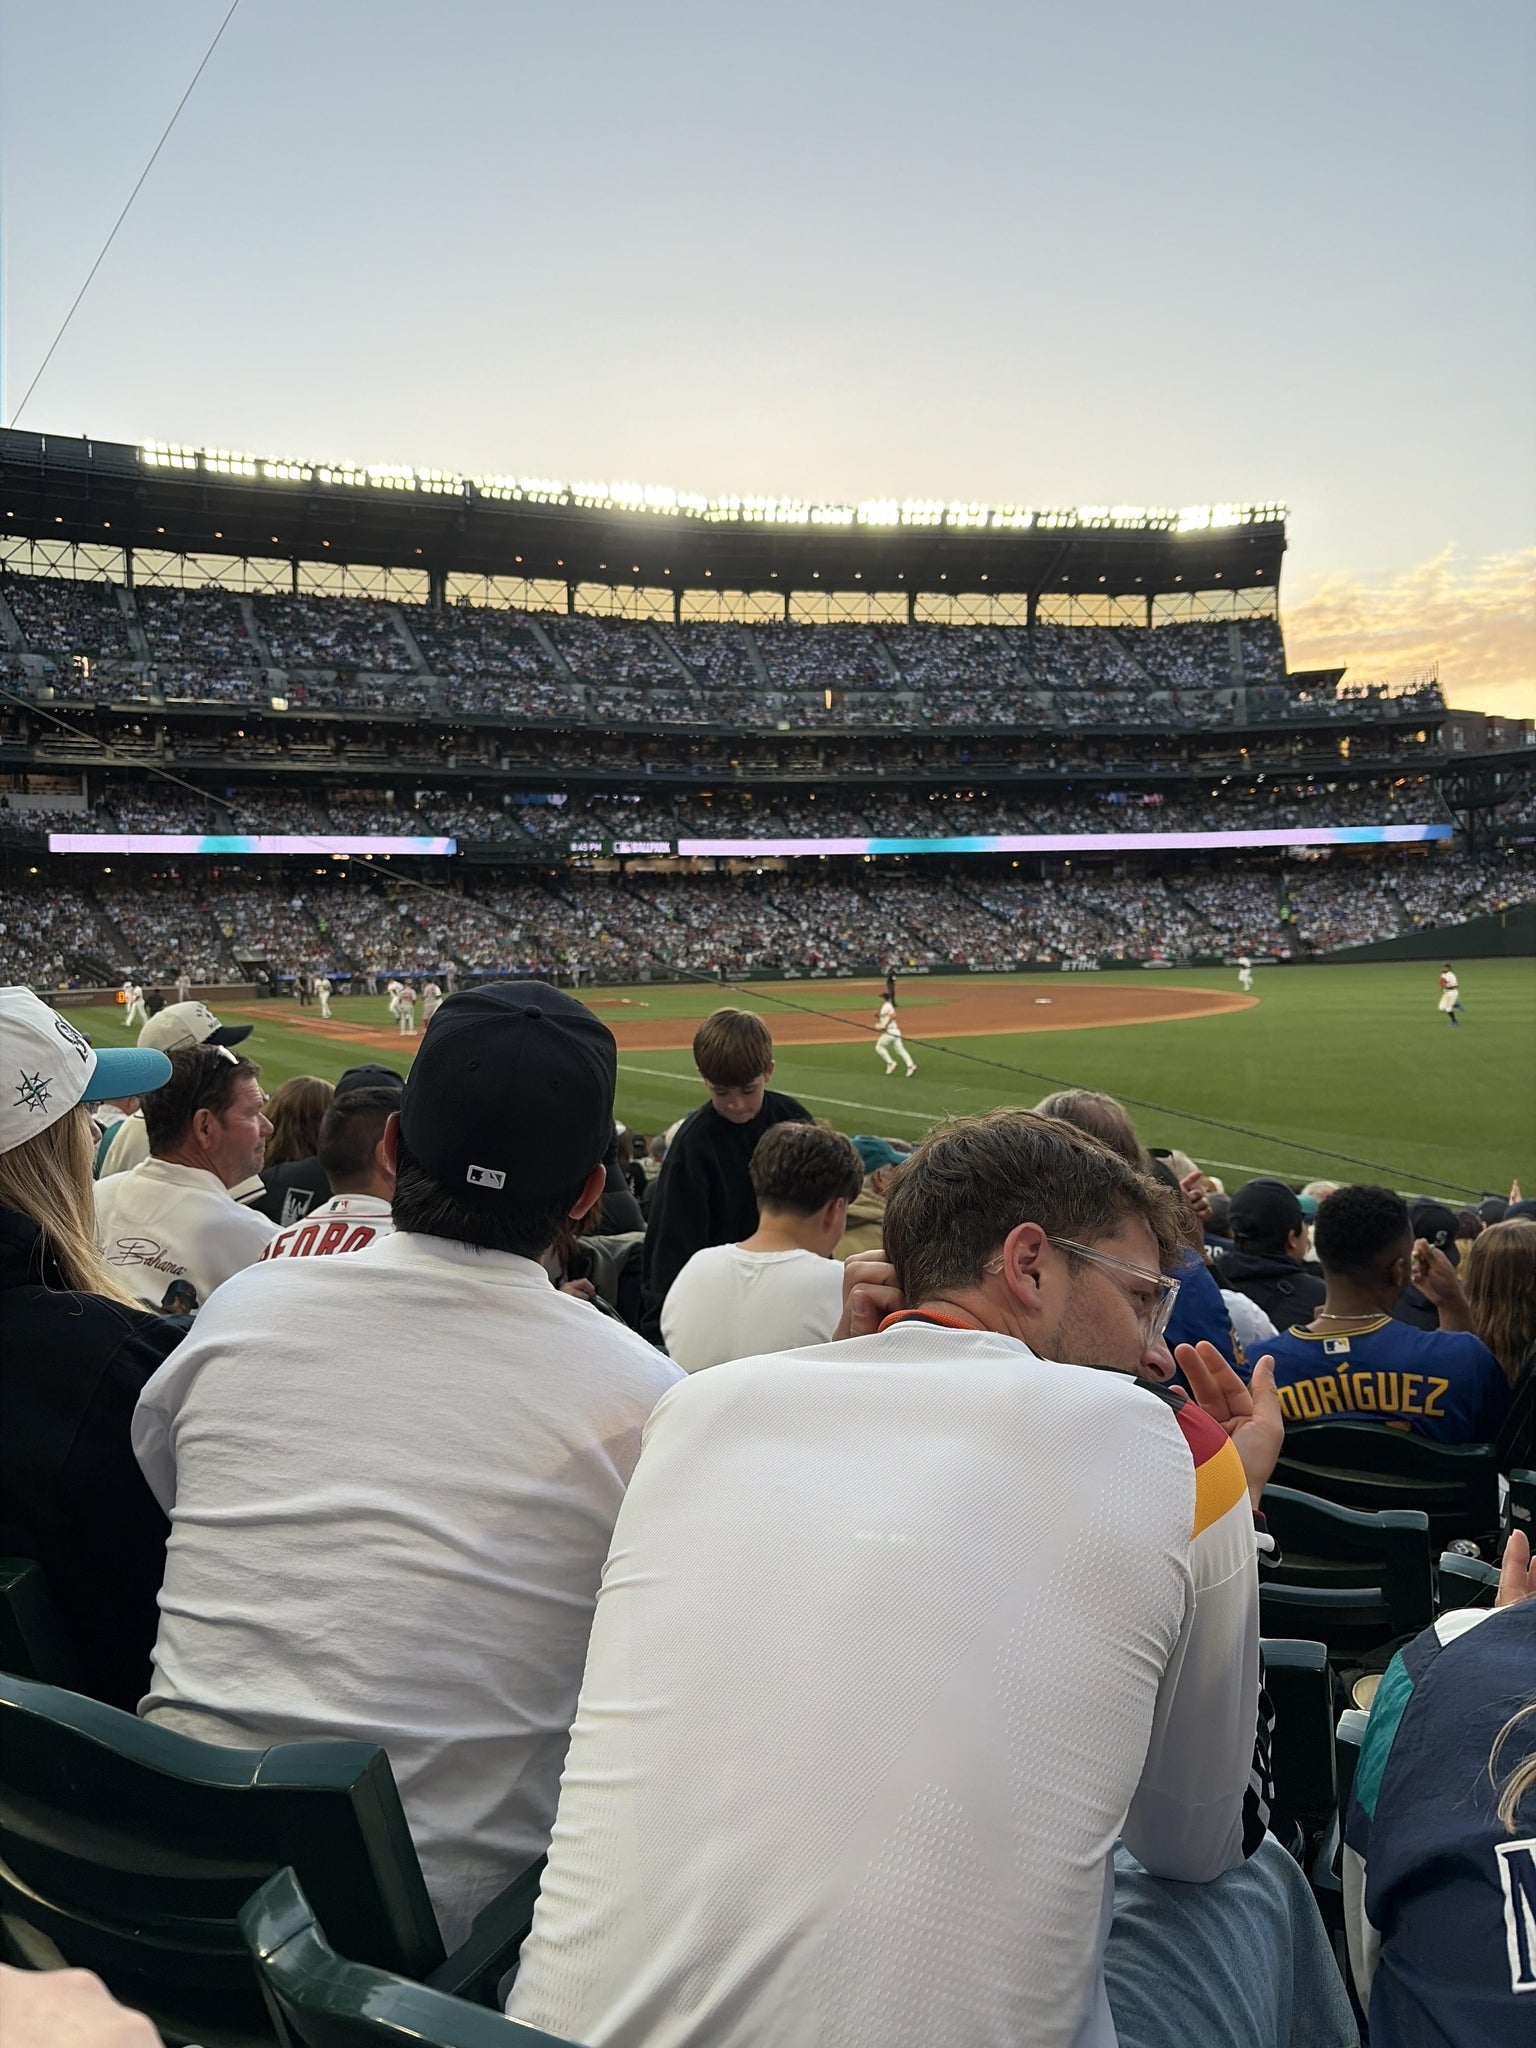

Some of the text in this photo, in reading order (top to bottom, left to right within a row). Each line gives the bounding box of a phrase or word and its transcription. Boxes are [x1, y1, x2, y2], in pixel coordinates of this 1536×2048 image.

[969, 963, 1016, 973] Great Clips
[1061, 960, 1100, 971] STIHL
[107, 1238, 185, 1275] Bahama
[1277, 1361, 1449, 1421] ODRÍGUEZ
